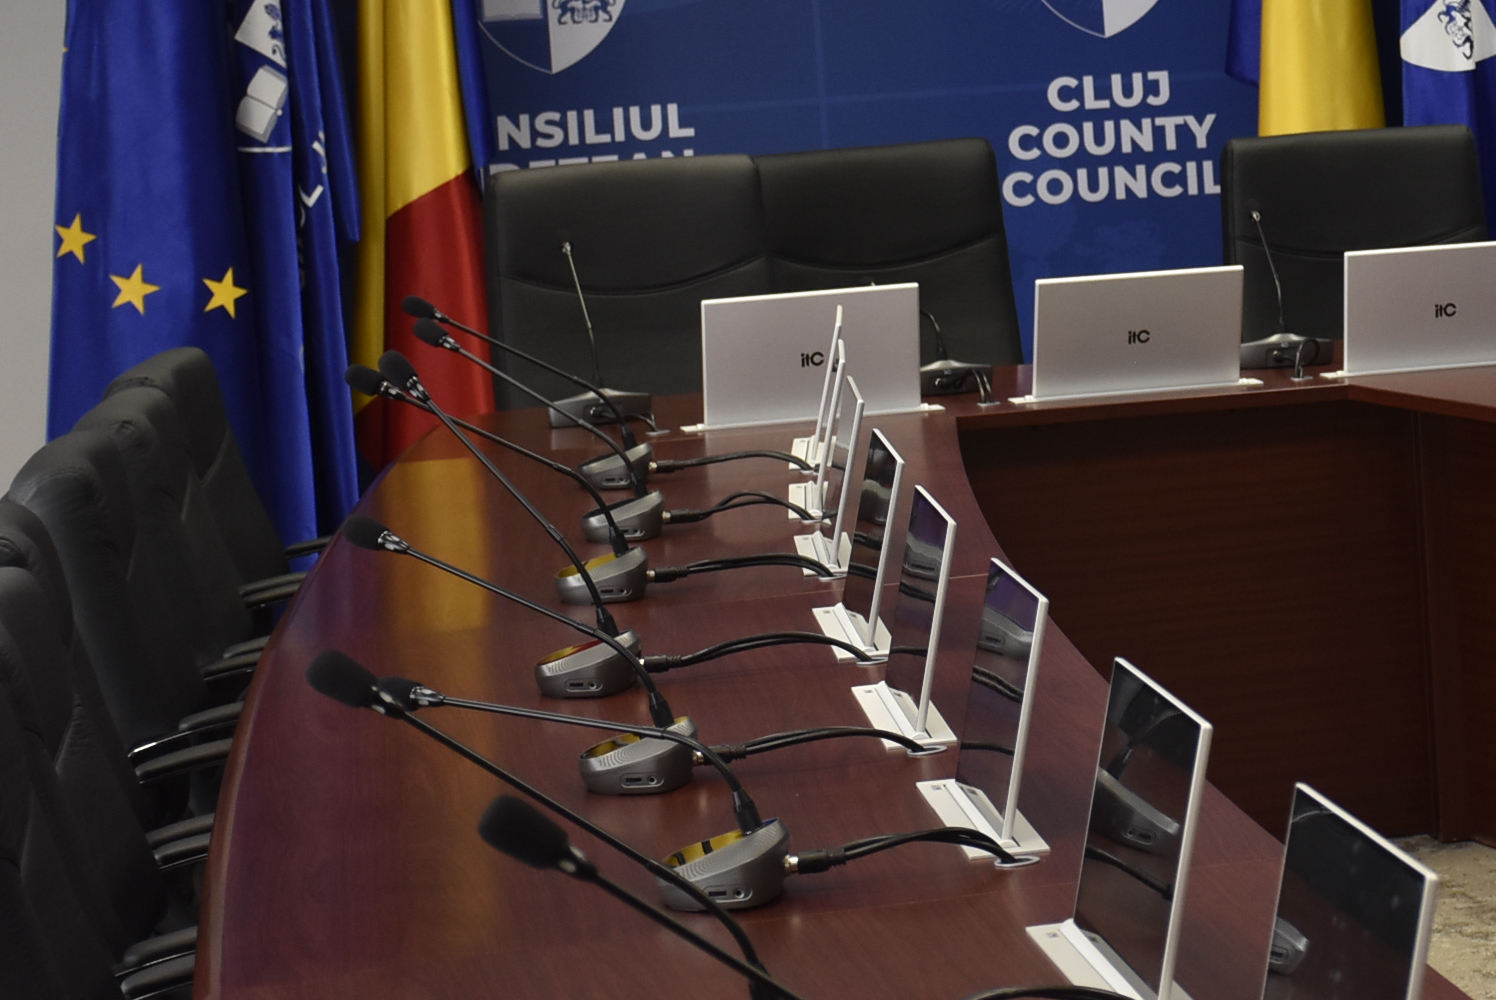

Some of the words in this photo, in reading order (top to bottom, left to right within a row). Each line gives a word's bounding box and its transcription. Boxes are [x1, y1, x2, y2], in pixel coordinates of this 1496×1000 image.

[1046, 70, 1170, 112] CLUJ
[497, 103, 695, 150] NSILIUL
[1008, 113, 1217, 161] COUNTY
[1002, 160, 1222, 207] COUNCIL
